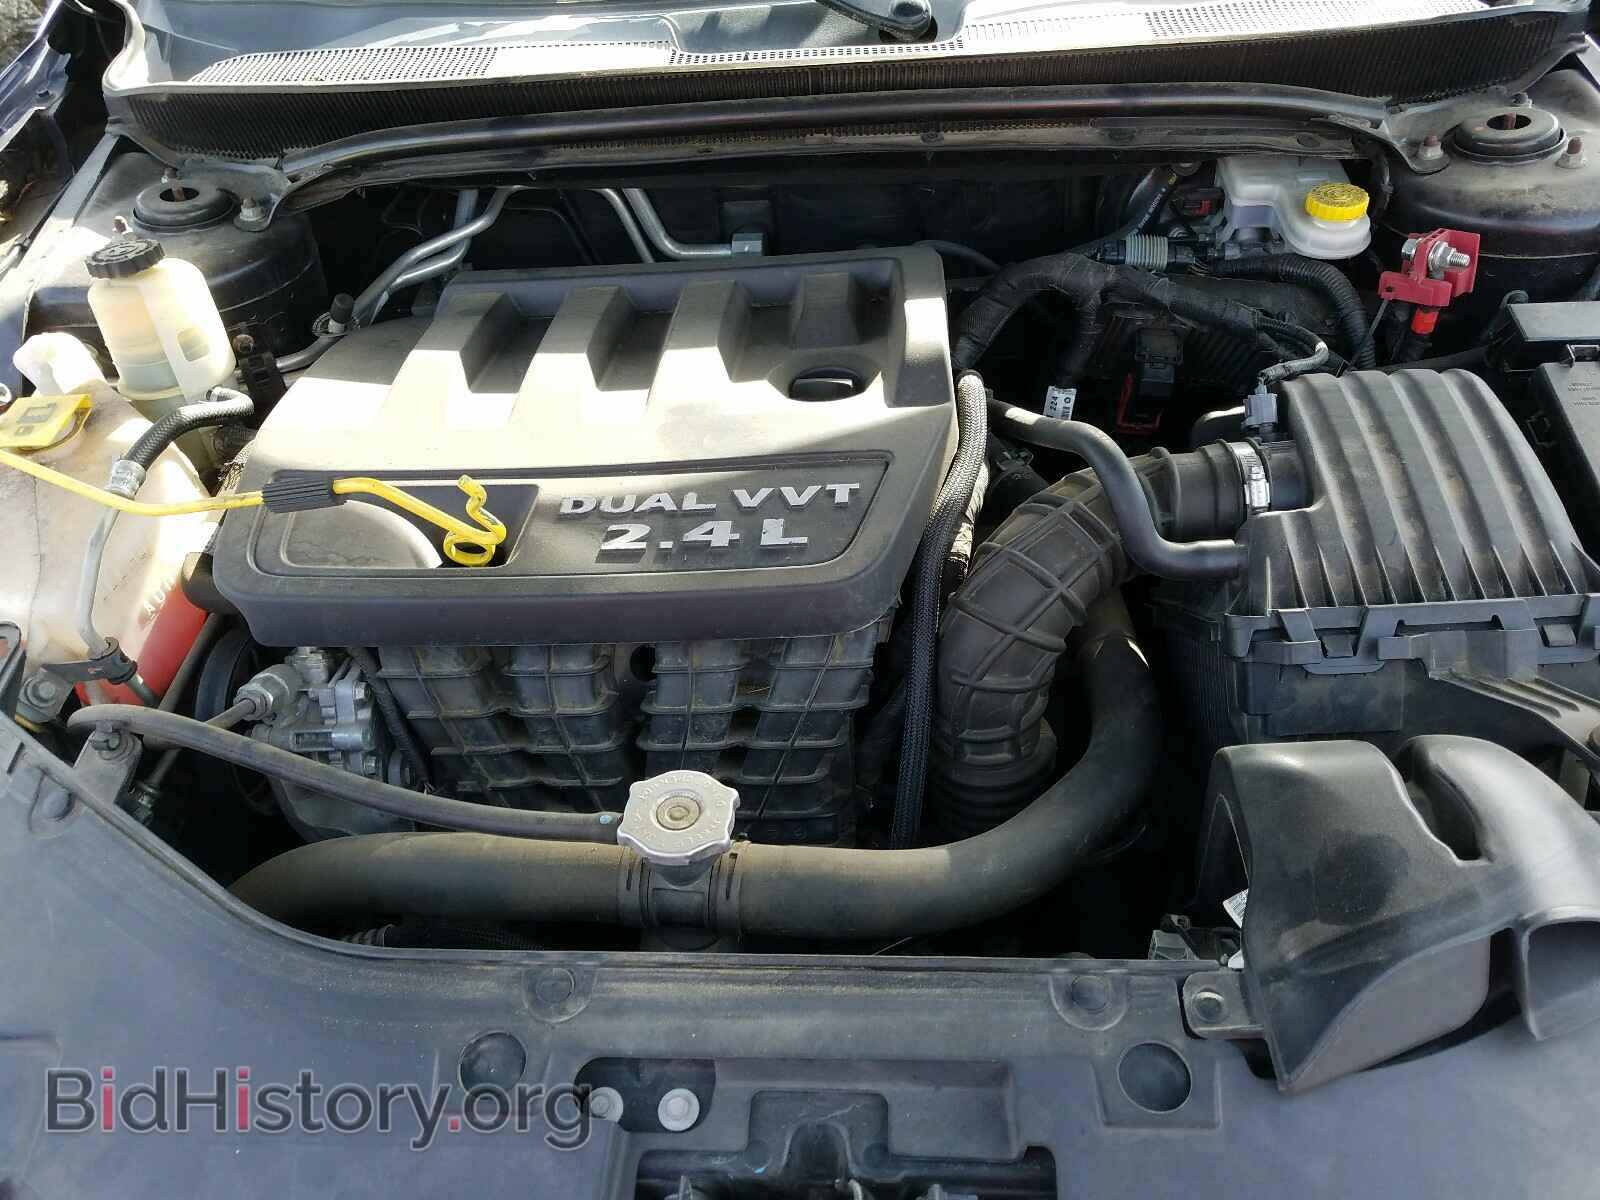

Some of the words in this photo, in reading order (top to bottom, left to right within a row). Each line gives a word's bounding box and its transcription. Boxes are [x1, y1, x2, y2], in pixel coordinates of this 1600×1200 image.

[559, 491, 717, 514] DUAL
[732, 482, 860, 508] VVT
[599, 520, 740, 550] 2.4
[760, 518, 808, 546] L
